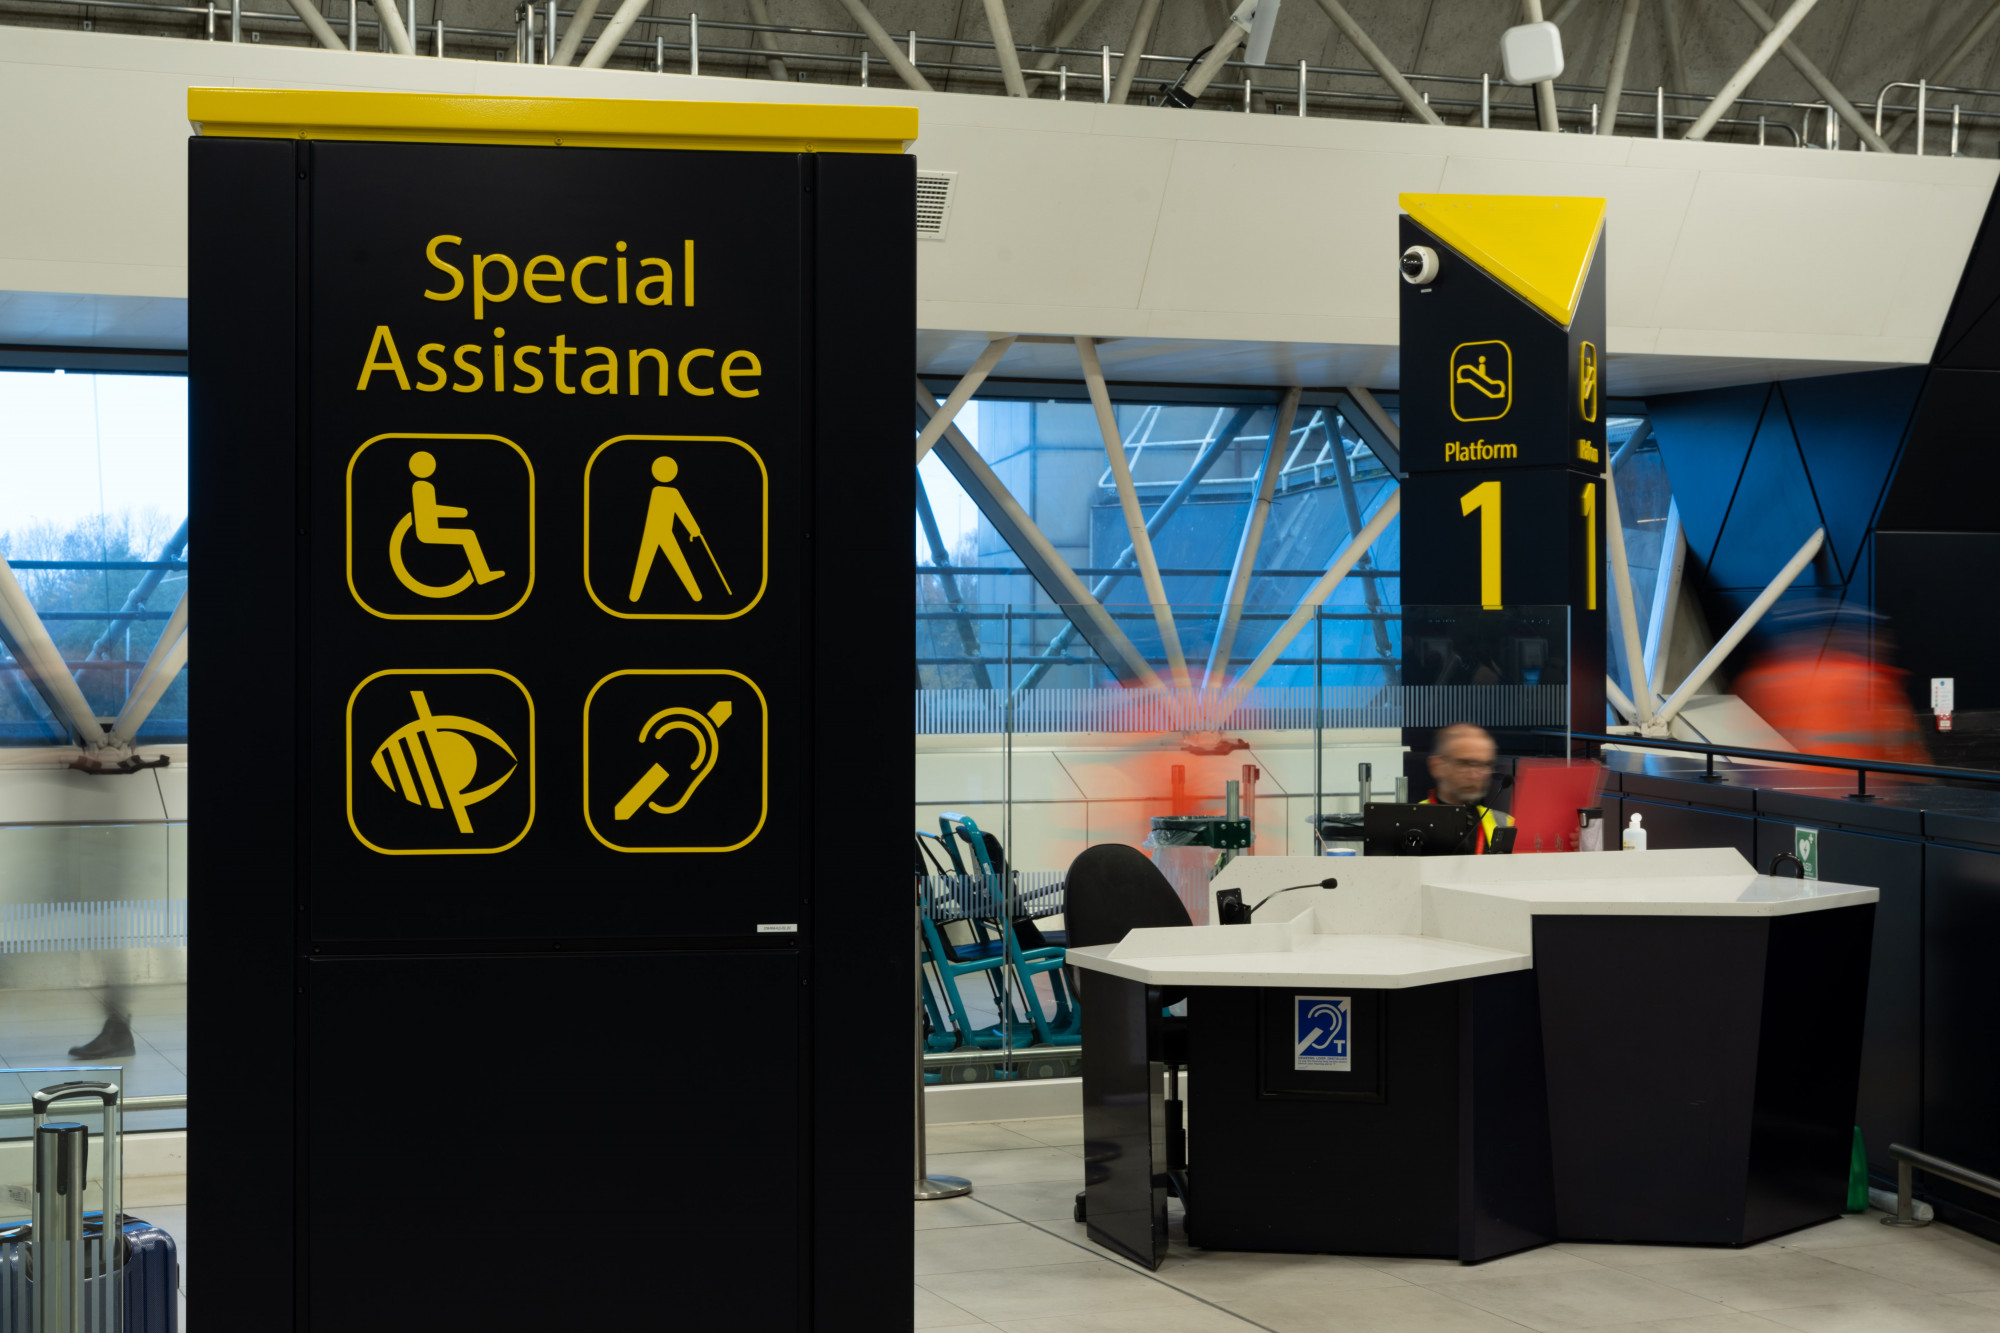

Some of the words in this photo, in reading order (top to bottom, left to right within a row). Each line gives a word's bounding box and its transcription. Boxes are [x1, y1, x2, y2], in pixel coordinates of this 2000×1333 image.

[424, 234, 694, 320] Special
[357, 325, 762, 398] Assistance
[1445, 439, 1518, 463] Platform
[1460, 481, 1503, 610] 1
[1581, 482, 1597, 610] 1
[1334, 1040, 1345, 1053] T
